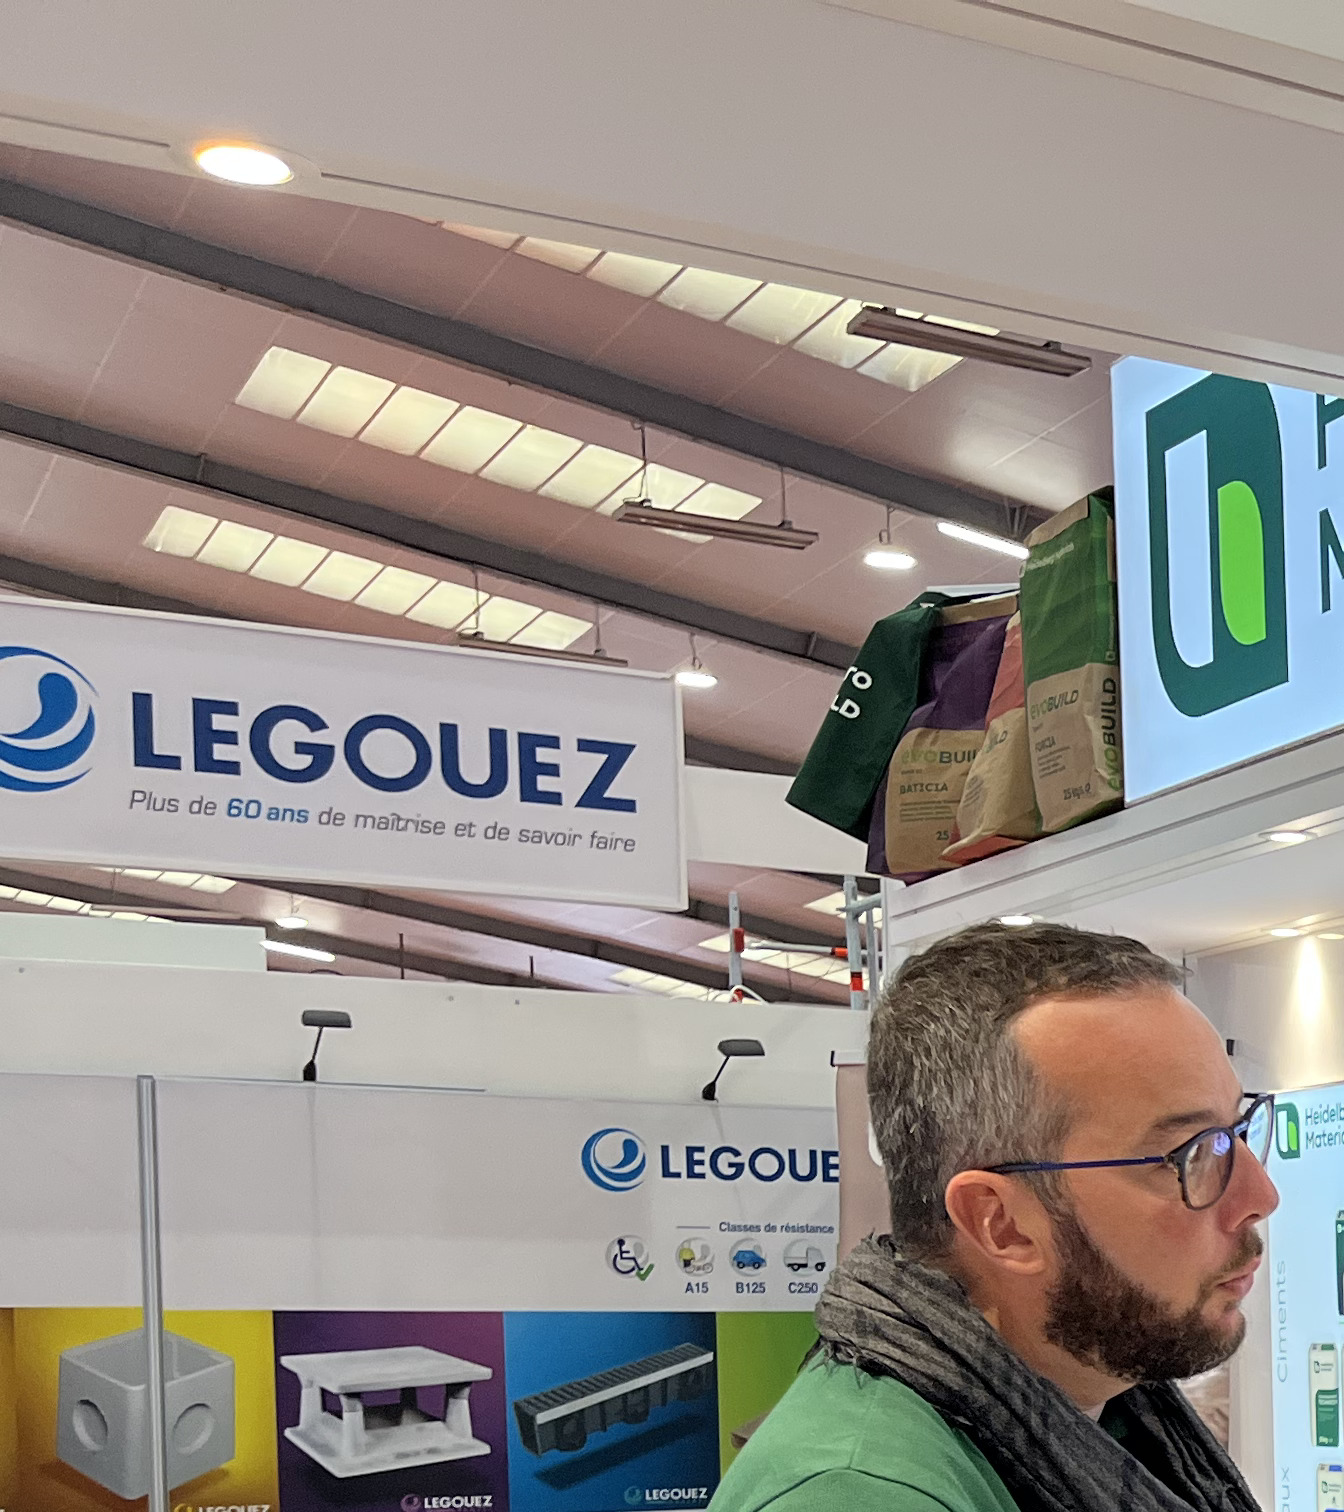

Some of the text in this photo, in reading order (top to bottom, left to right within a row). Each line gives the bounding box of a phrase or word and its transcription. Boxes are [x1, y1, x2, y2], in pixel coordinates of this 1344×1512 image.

[1101, 677, 1121, 791] evoBUILD
[131, 691, 638, 813] LEGOUEZ
[901, 749, 977, 764] evoBUI
[129, 790, 636, 852] Plus de 60 ans de maîtrise et de savoir faire
[660, 1144, 840, 1183] LEGOUE
[719, 1221, 835, 1234] Classes de résistance
[685, 1282, 709, 1294] A15
[735, 1282, 766, 1294] B125
[788, 1282, 819, 1294] C250
[1277, 1260, 1288, 1384] Ciments
[645, 1487, 708, 1501] LEGOUEZ
[424, 1495, 493, 1509] LEGOUEZ
